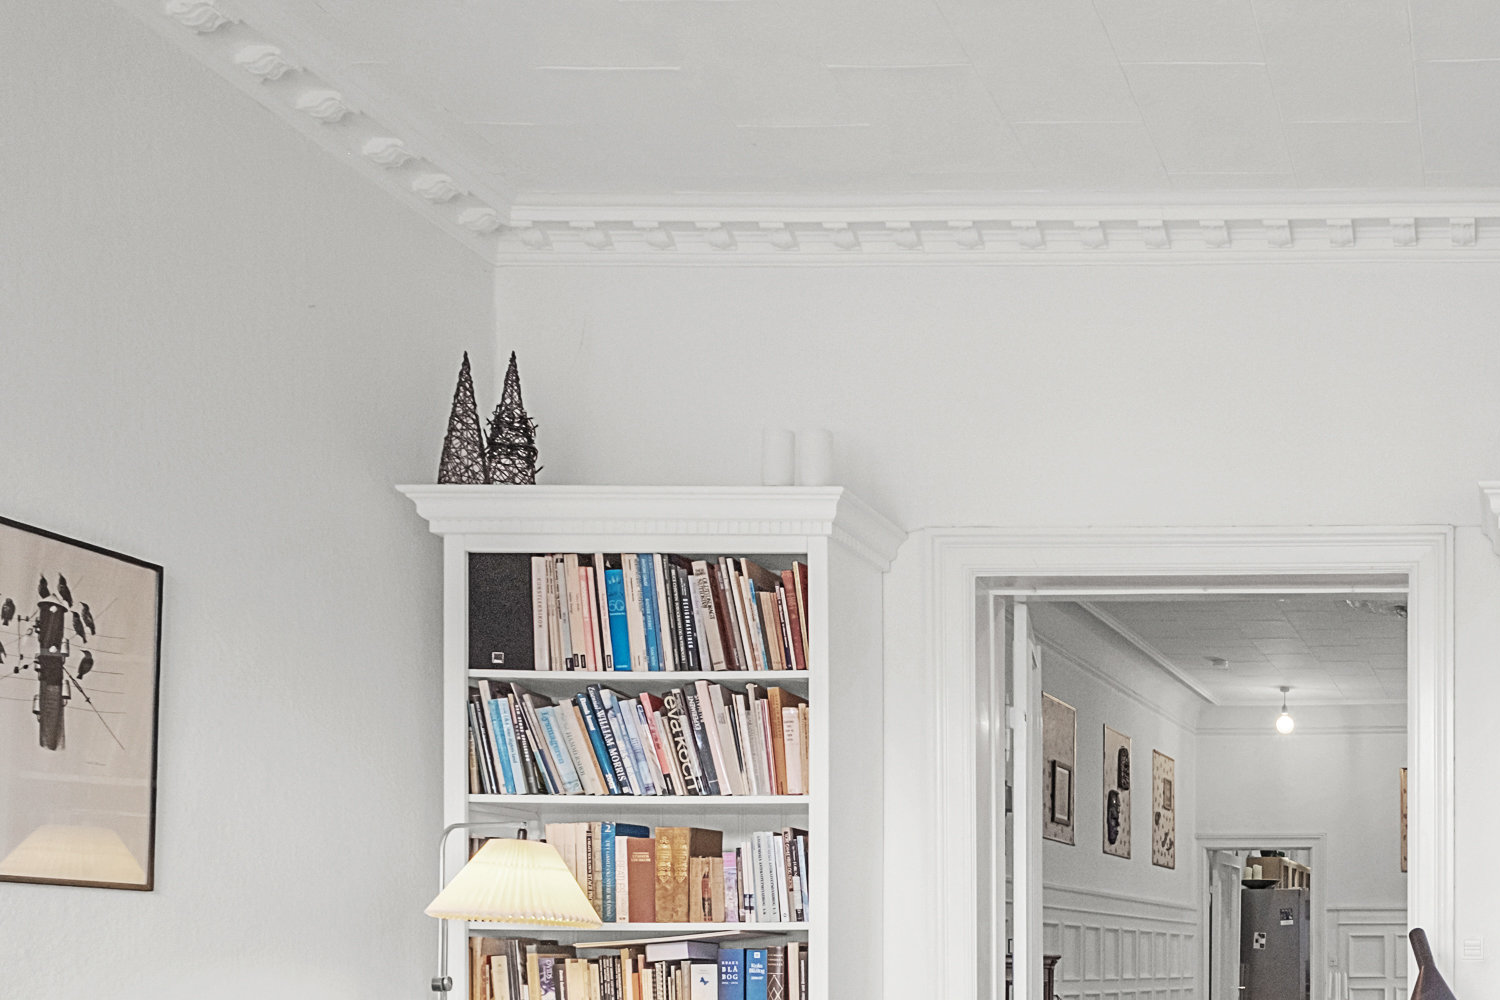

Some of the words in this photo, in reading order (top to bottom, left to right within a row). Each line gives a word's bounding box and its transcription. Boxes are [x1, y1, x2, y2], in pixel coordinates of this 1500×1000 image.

[663, 695, 681, 734] eva
[596, 709, 615, 747] WILLIAM
[608, 747, 627, 782] MORRIS
[604, 824, 611, 833] 2
